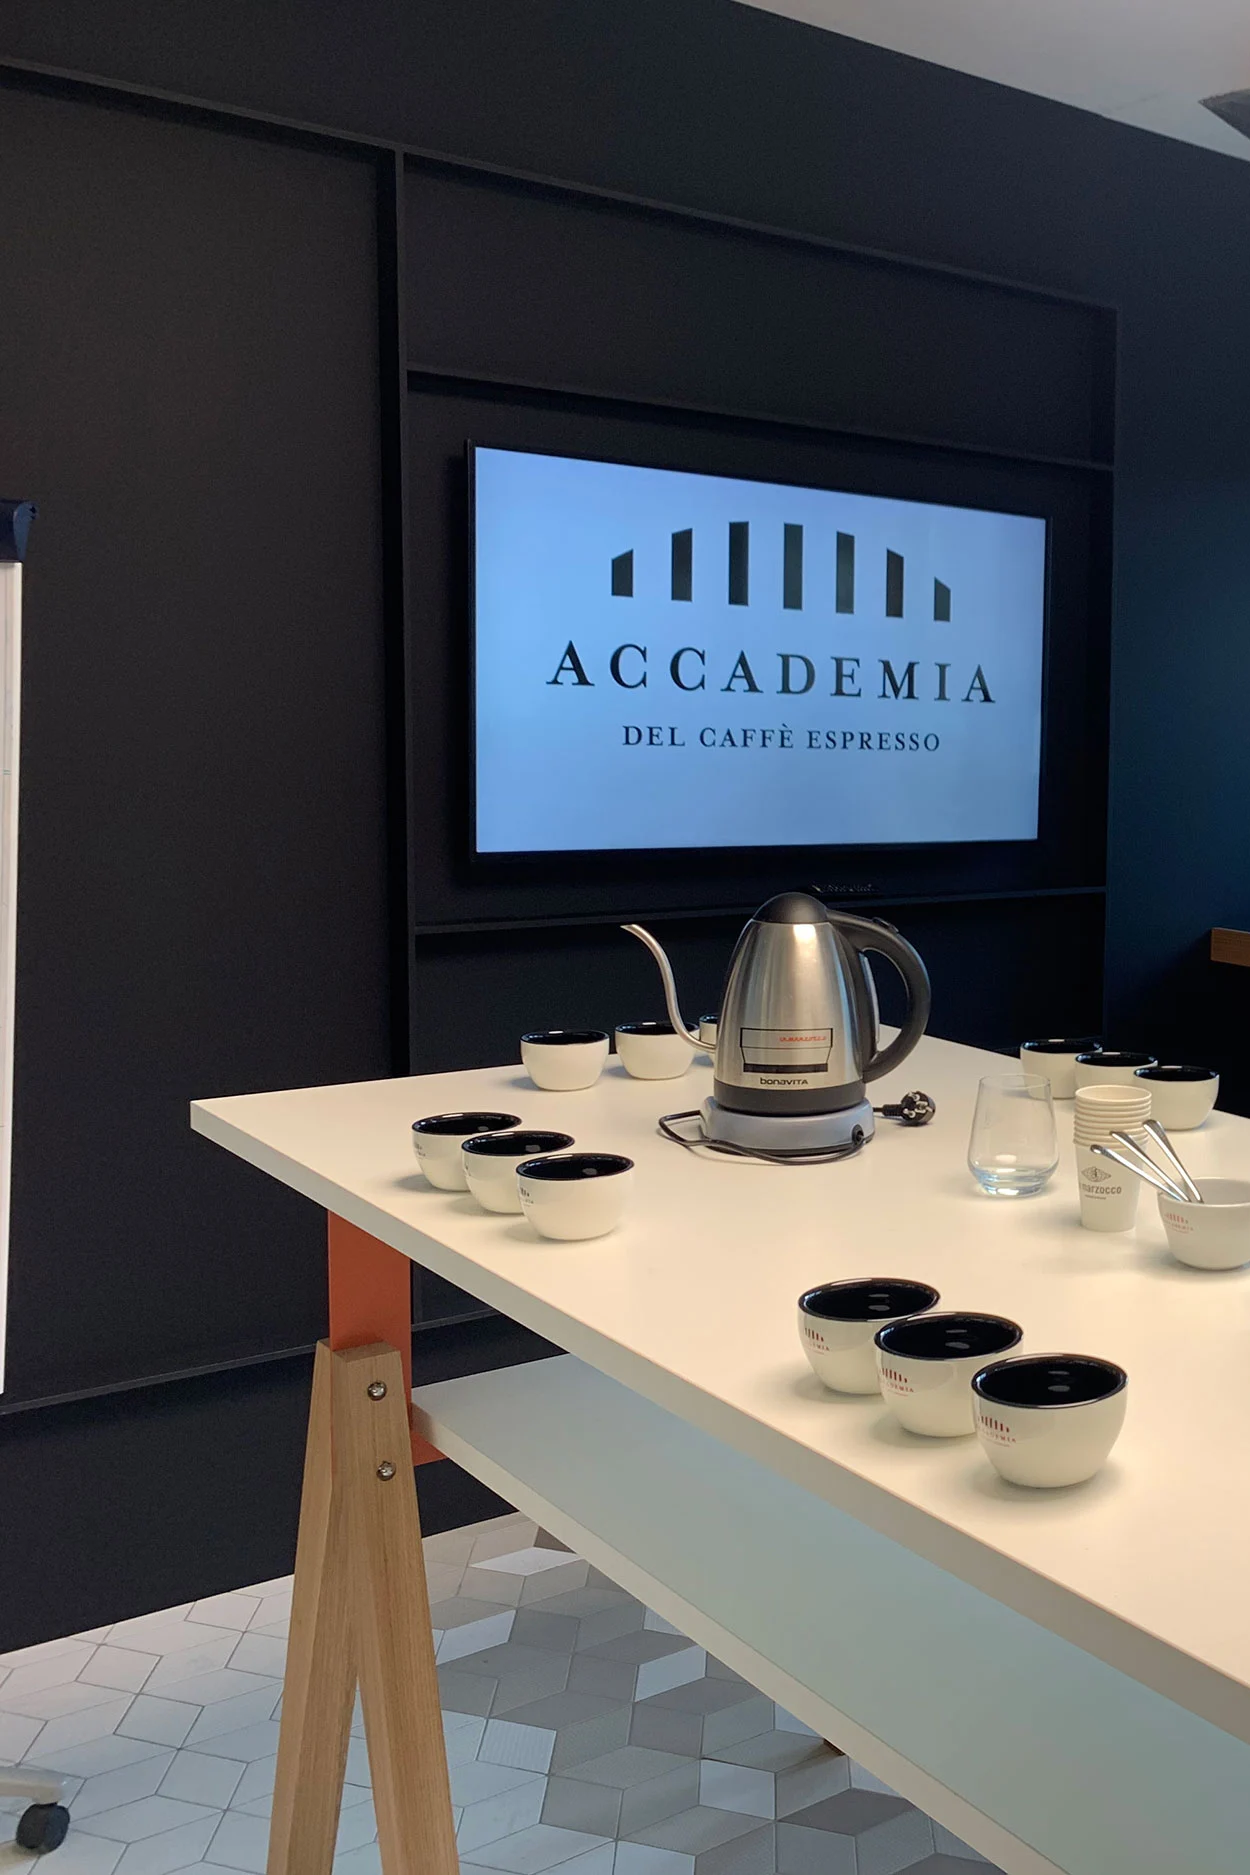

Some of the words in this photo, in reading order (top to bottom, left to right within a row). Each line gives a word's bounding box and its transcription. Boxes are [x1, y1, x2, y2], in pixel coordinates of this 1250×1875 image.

[546, 640, 996, 704] ACCADEMIA
[622, 724, 686, 748] DEL
[699, 723, 794, 750] CAFFÈ
[806, 730, 941, 752] ESPRESSO
